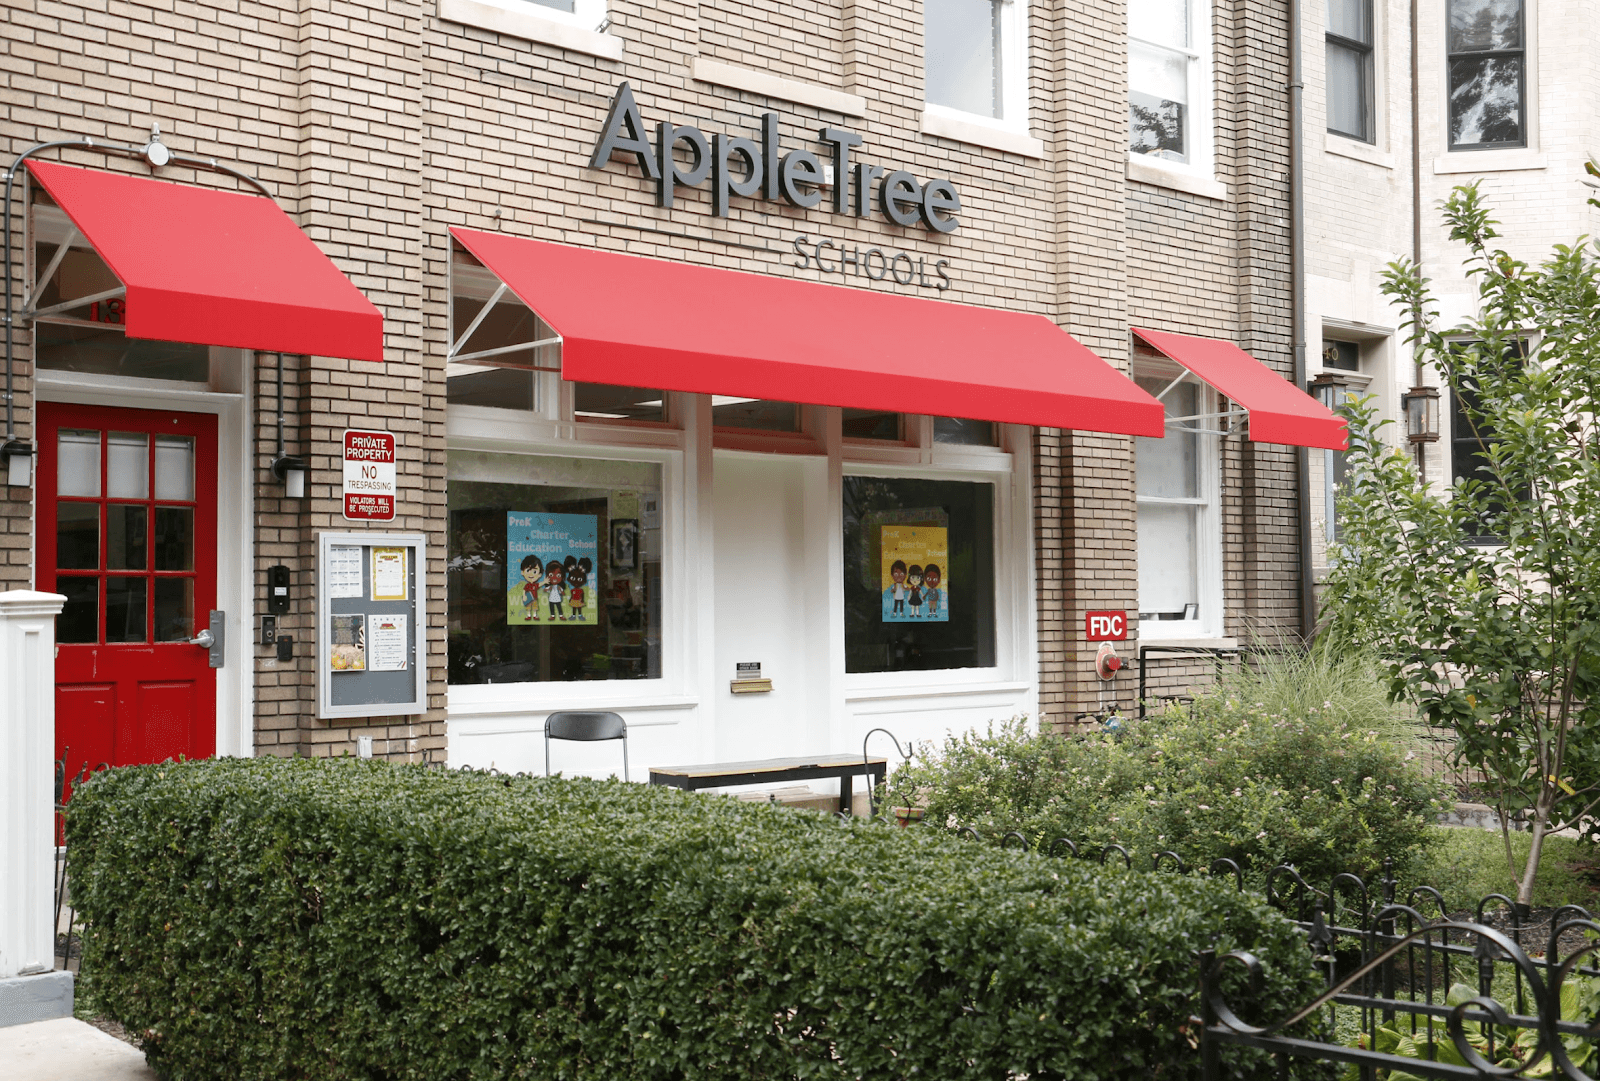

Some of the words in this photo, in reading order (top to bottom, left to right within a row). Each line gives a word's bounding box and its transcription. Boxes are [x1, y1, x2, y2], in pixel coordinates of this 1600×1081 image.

[588, 81, 961, 233] AppleTree
[794, 236, 950, 290] SCHOOLS
[352, 437, 387, 449] PRIVATE
[346, 447, 392, 460] PROPERTY
[362, 465, 377, 479] NO
[348, 480, 391, 490] TRESPASSING
[349, 497, 375, 505] VIOLATORS
[378, 498, 389, 506] WILL
[359, 505, 389, 513] PROSECUTED
[509, 516, 532, 527] PreK
[531, 529, 569, 540] Charter
[509, 541, 562, 553] Education
[569, 539, 596, 549] School
[1090, 615, 1122, 636] FDC
